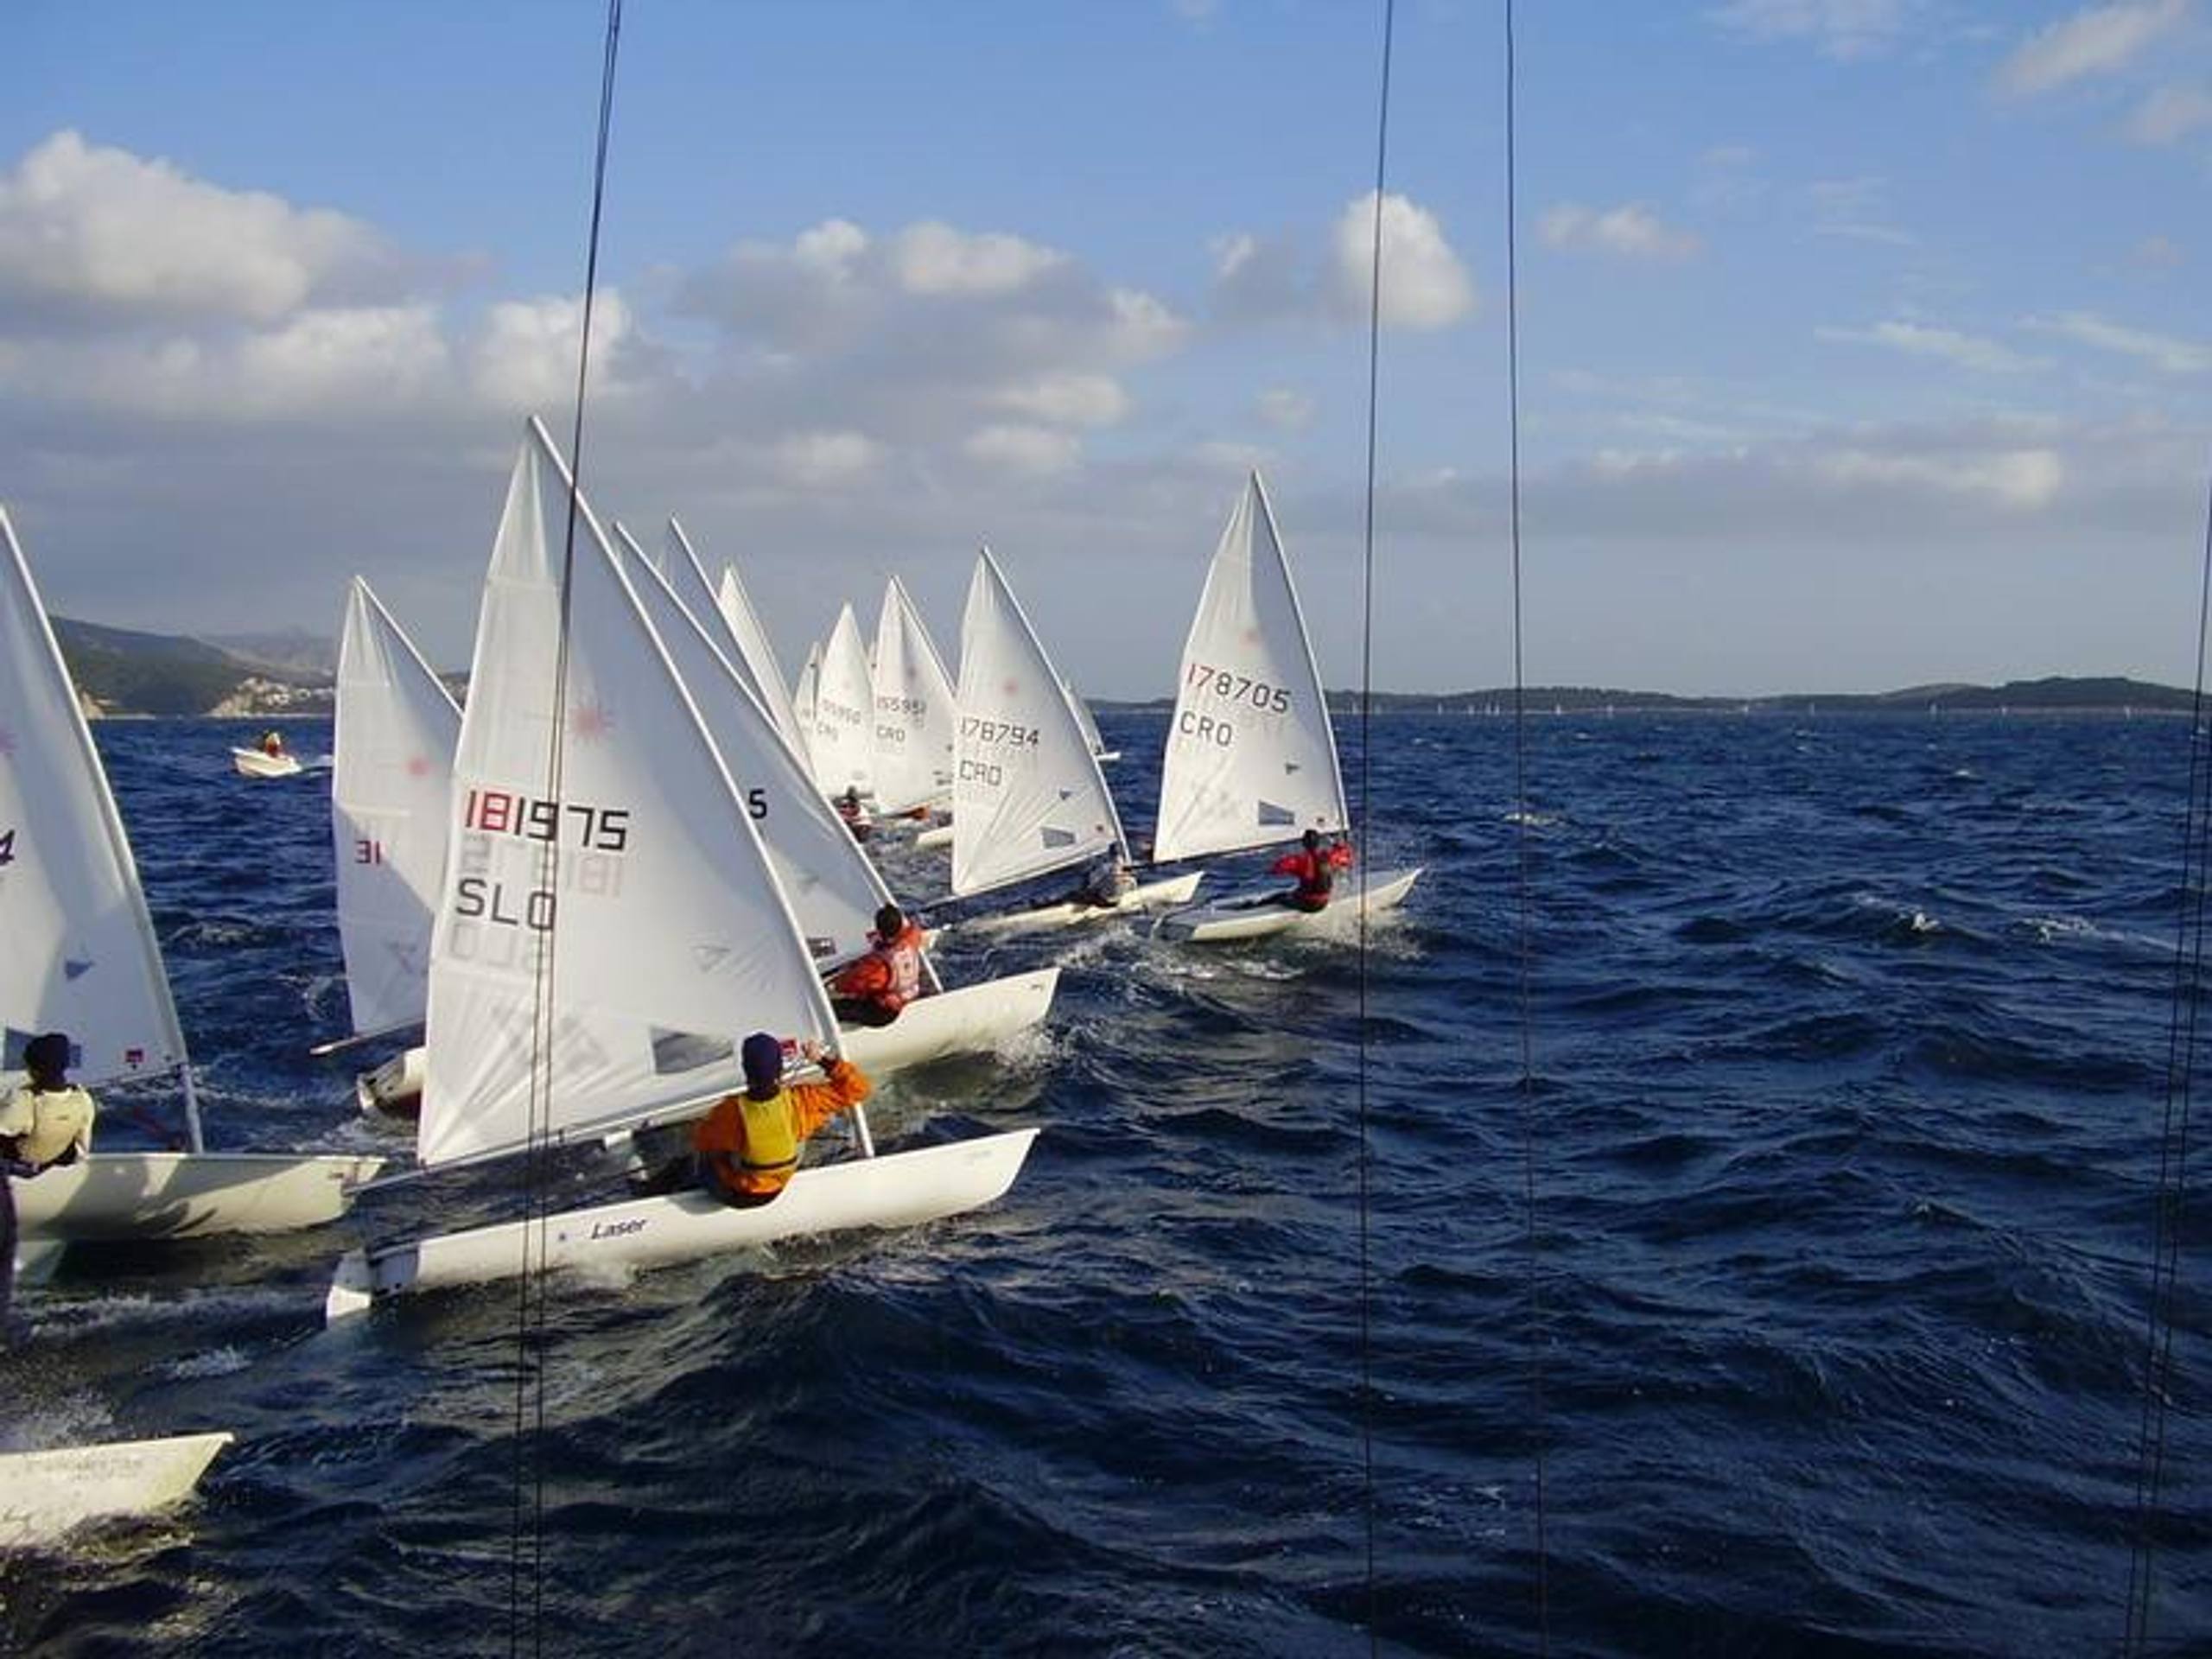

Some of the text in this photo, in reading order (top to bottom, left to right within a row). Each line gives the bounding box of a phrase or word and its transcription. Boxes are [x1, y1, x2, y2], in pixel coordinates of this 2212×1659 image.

[1188, 664, 1291, 714] 178705
[961, 716, 1040, 747] 178794
[1180, 710, 1233, 747] CRO
[960, 760, 1002, 786] CRO
[465, 790, 630, 852] 181975
[748, 787, 767, 820] 5
[455, 877, 556, 931] SLO
[590, 1218, 647, 1240] Laser
